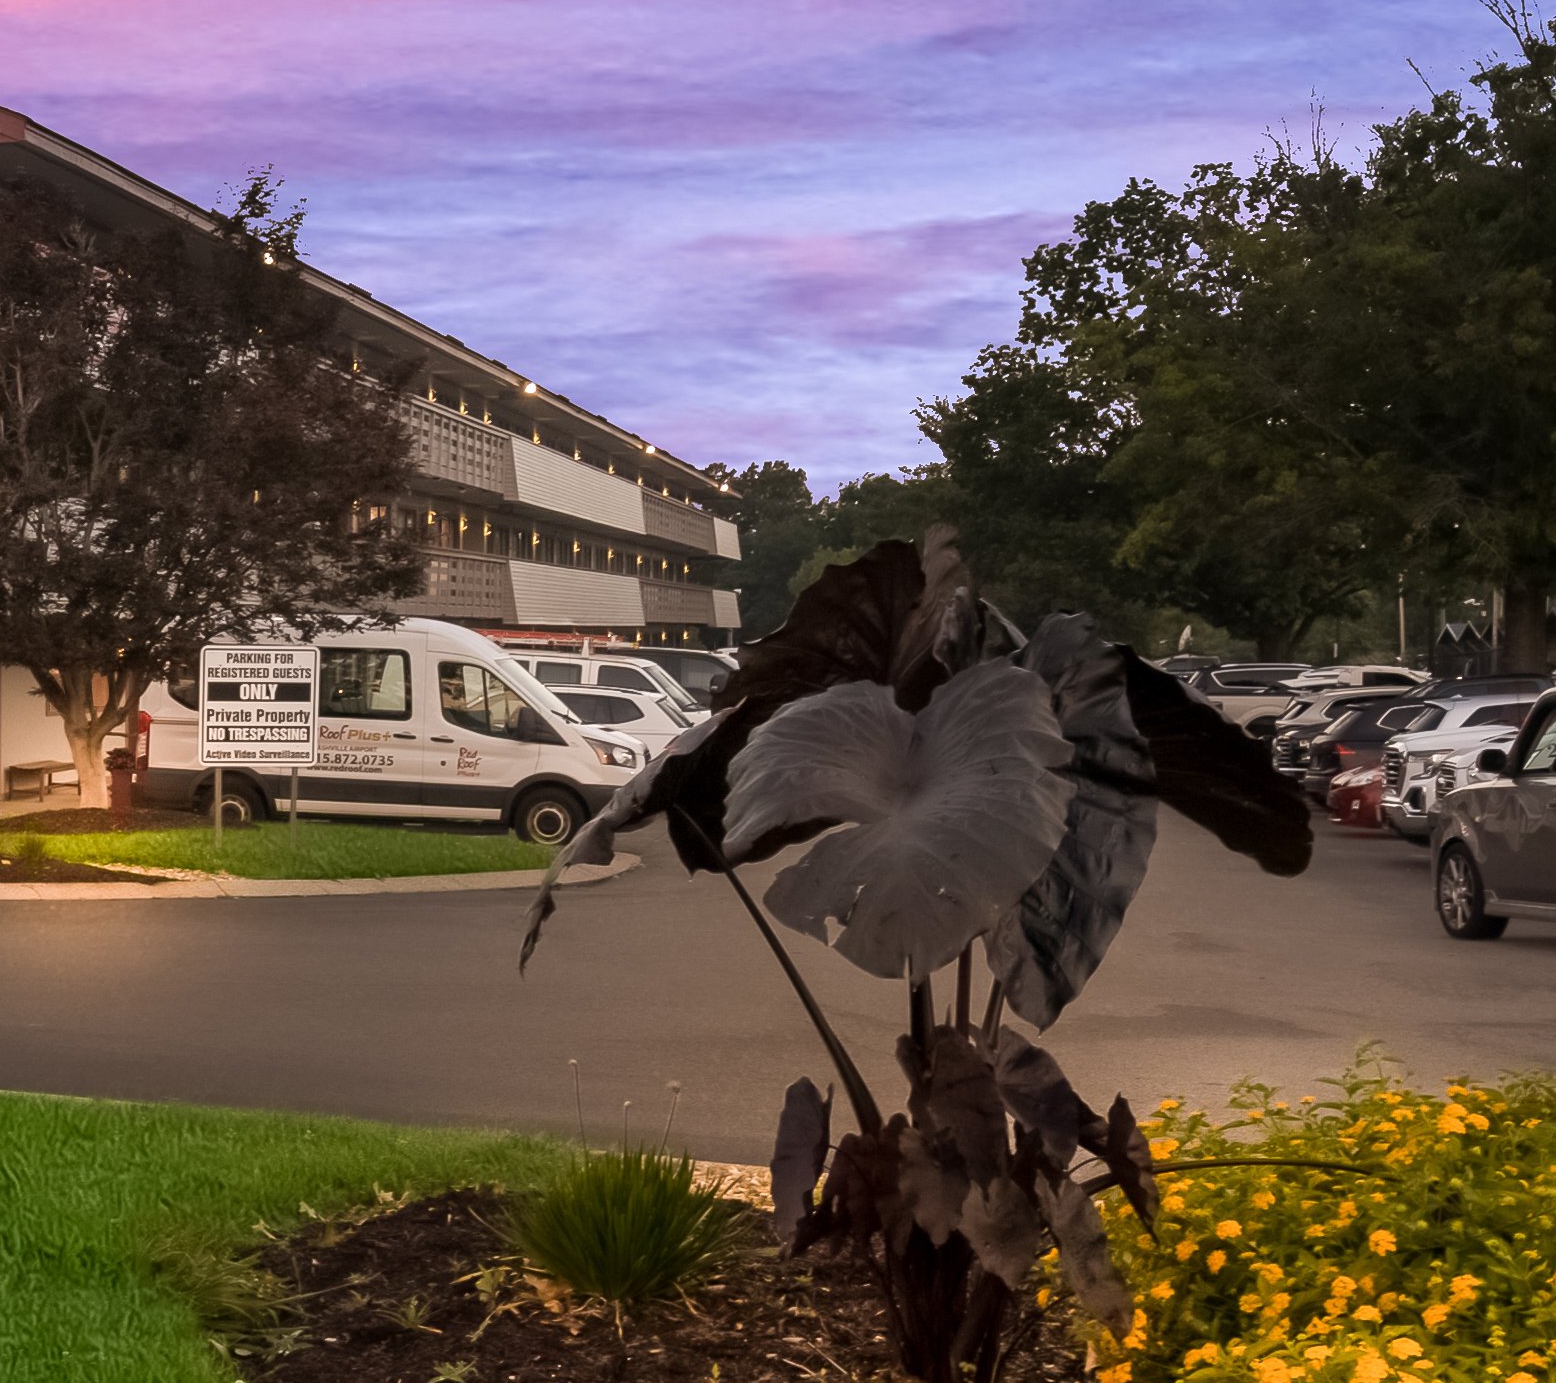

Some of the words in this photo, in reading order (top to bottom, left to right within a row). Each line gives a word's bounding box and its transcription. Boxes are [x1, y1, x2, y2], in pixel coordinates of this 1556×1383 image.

[226, 652, 271, 664] PARKING
[274, 653, 294, 664] FOR
[207, 667, 270, 679] REGISTERED
[272, 667, 312, 679] GUESTS
[239, 683, 278, 700] ONLY
[206, 708, 252, 723] Private
[256, 708, 311, 724] Property
[208, 727, 226, 741] NO
[227, 727, 308, 741] TRESPASSING
[319, 724, 349, 741] Roof
[346, 729, 392, 742] Plus+
[206, 749, 231, 759] Active
[233, 749, 257, 759] Video
[258, 749, 310, 759] Surveillance
[316, 752, 395, 766] 15.872.0735
[459, 746, 478, 758] Red
[457, 757, 482, 771] Roof
